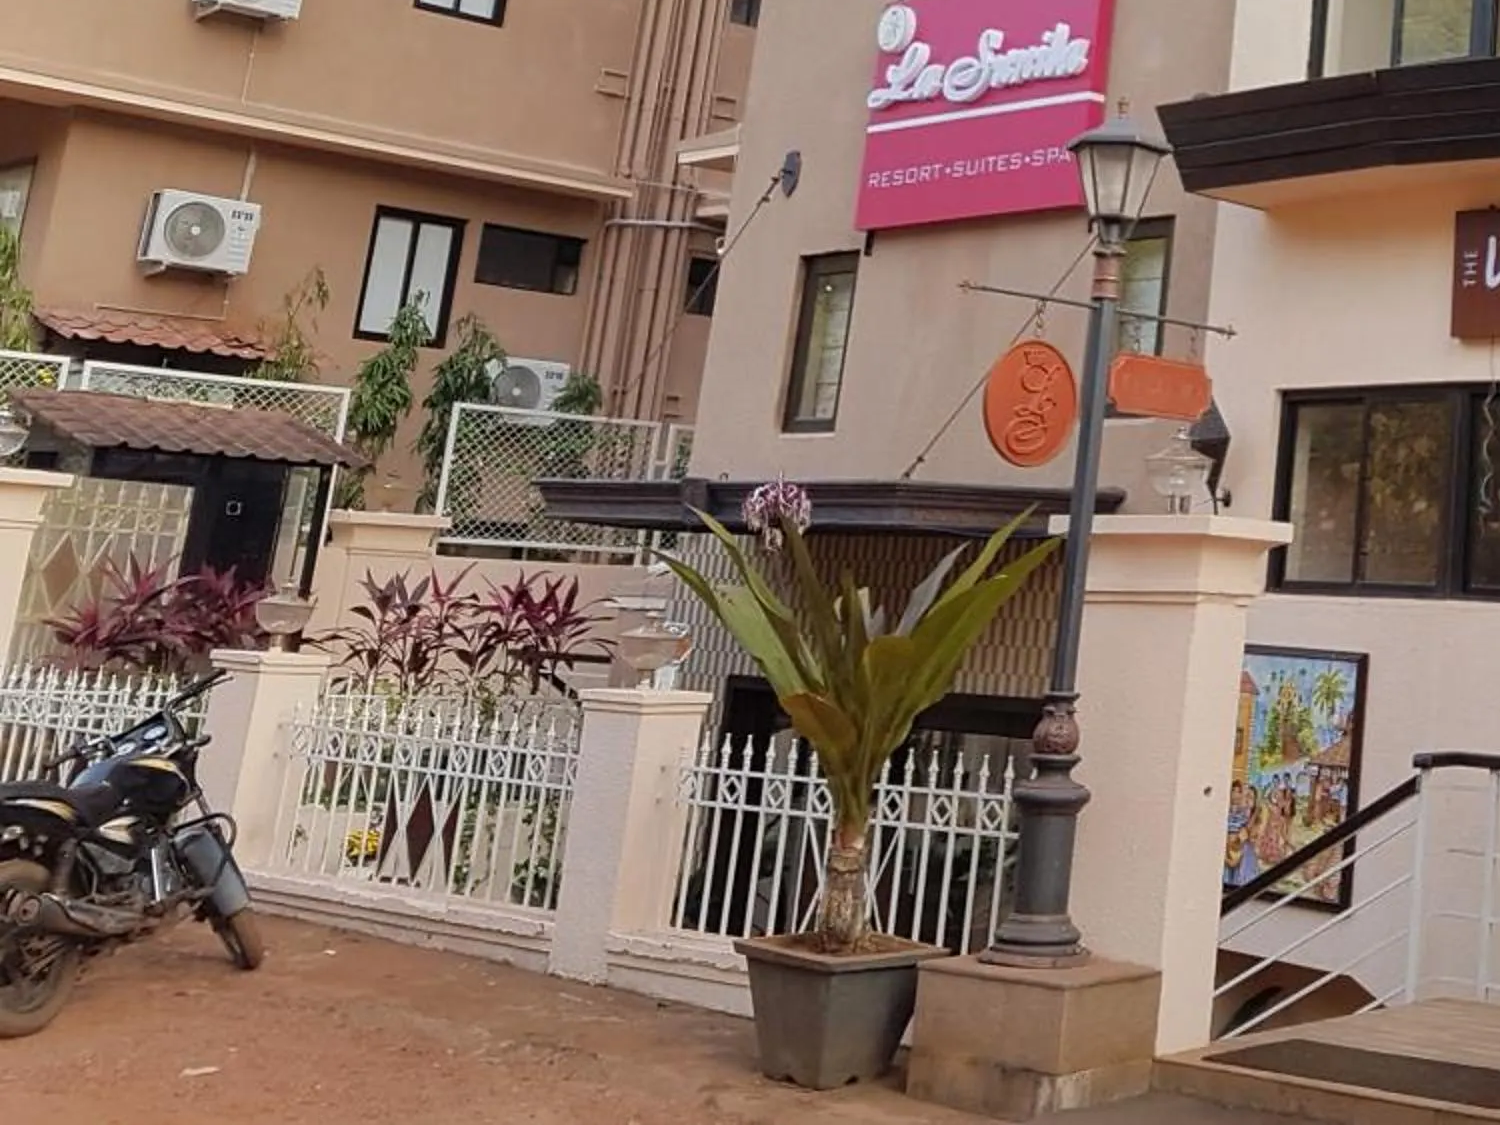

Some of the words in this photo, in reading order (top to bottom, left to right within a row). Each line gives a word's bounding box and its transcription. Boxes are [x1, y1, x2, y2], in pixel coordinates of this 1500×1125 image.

[867, 164, 943, 188] RESORT
[951, 152, 1023, 178] SUITES
[1028, 146, 1072, 167] SPA
[1463, 250, 1479, 287] THE
